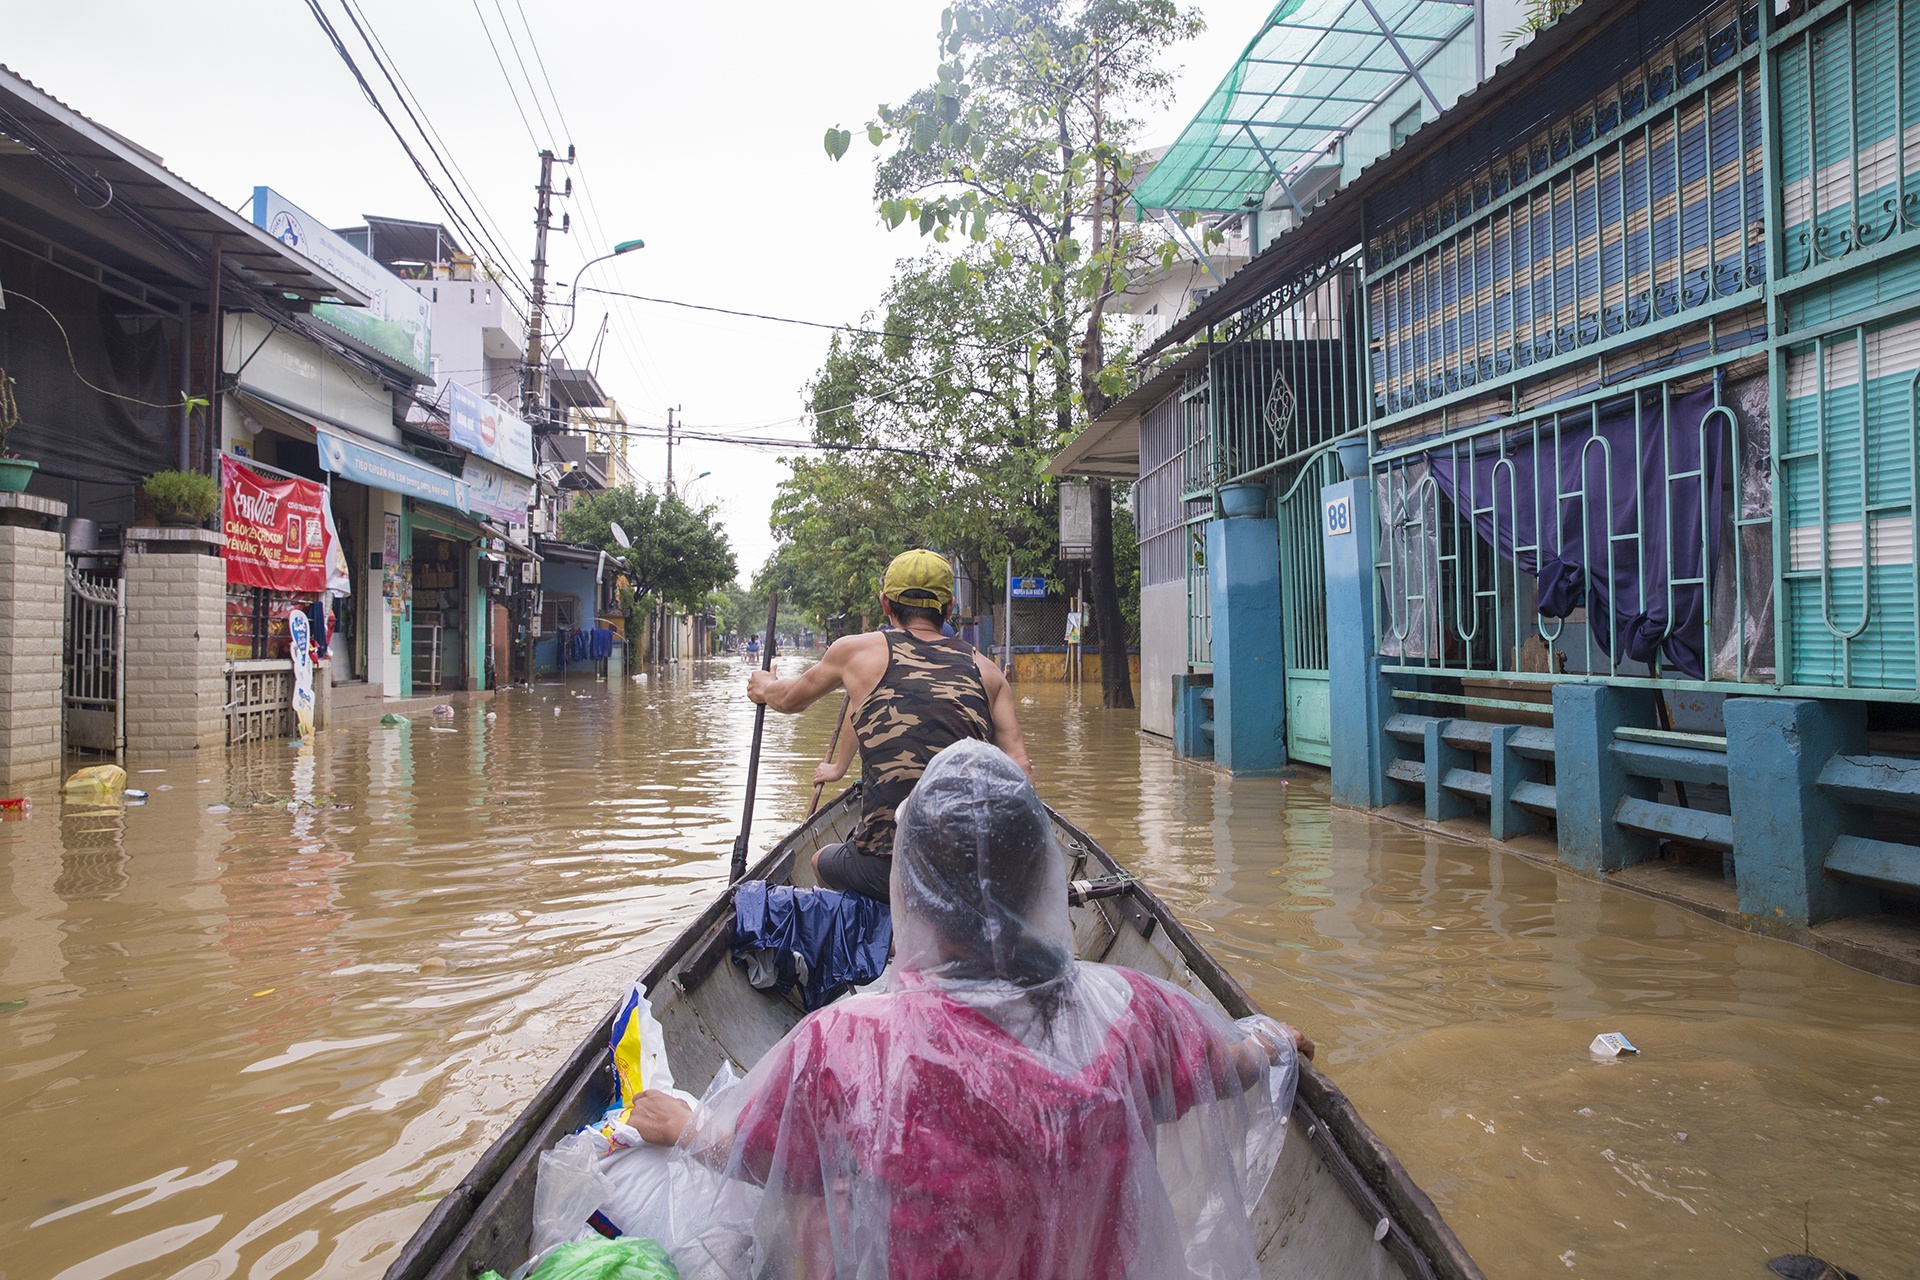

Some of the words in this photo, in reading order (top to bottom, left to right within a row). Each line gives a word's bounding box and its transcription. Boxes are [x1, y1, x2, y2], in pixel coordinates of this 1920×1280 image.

[1328, 502, 1347, 531] 88
[225, 521, 246, 536] CHÁO
[270, 532, 284, 545] CON
